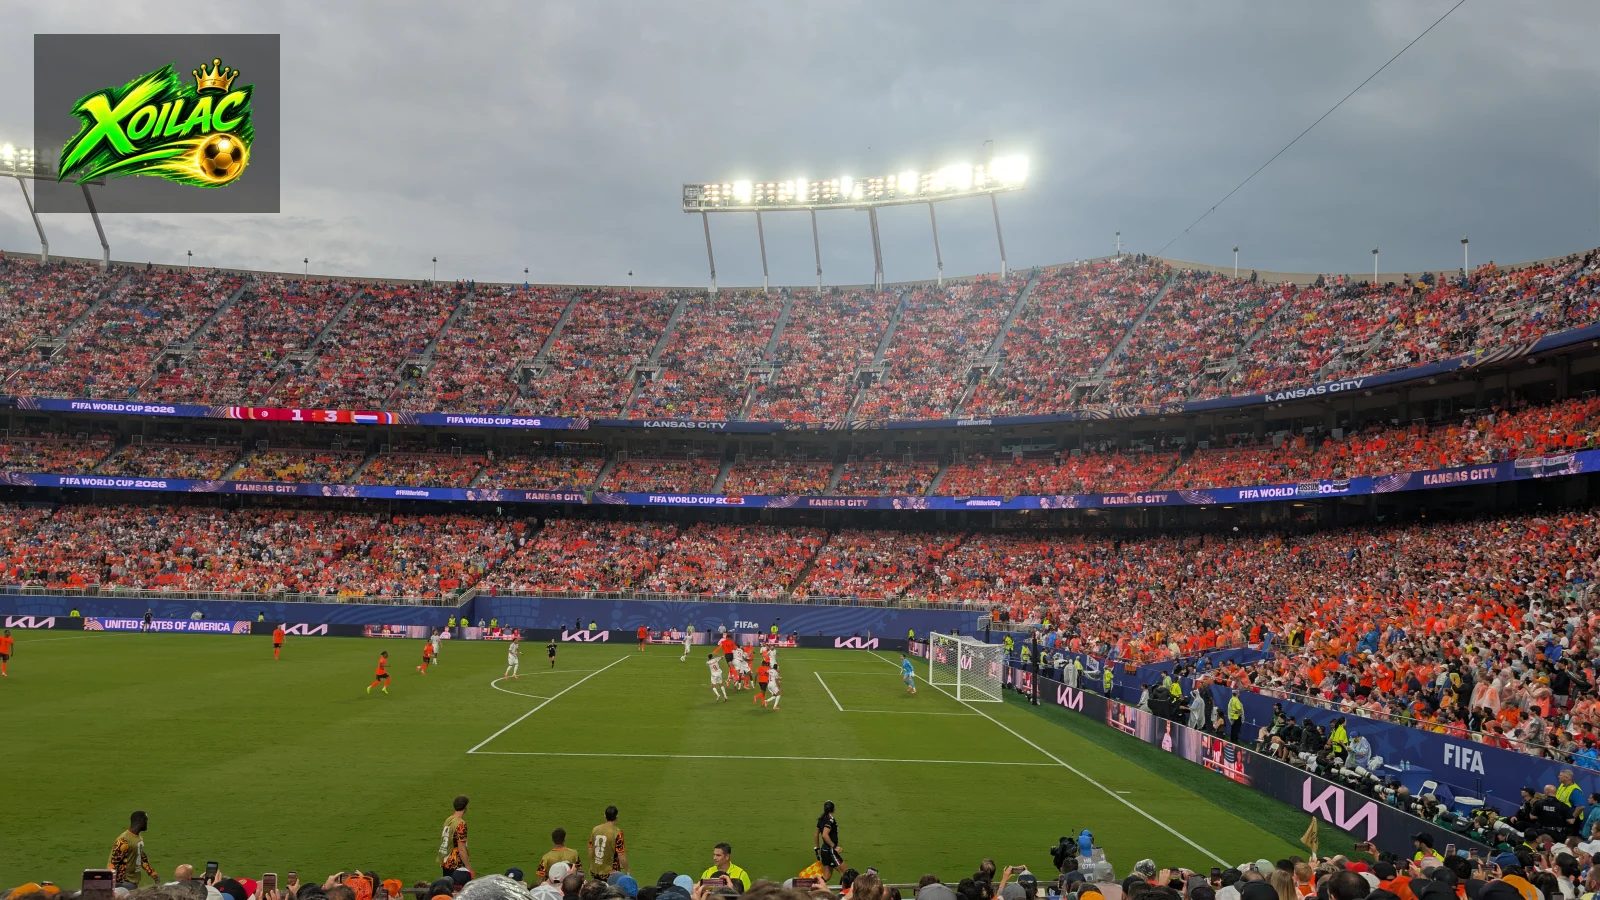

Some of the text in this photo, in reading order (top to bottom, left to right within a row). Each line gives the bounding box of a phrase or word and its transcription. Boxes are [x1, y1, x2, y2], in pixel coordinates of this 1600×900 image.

[1265, 379, 1364, 403] KANSAS CITY
[71, 402, 175, 414] FIFA WORLD CUP 2026
[291, 409, 338, 422] 1 3
[446, 416, 541, 426] FIFA WORLD CUP 2026
[643, 420, 727, 429] KANSAS CITY
[1423, 468, 1497, 484] KANSAS CITY
[59, 477, 167, 489] FIFA WORLD CUP 2026
[235, 483, 297, 493] KANSAS CITY
[525, 492, 563, 501] KANSAS
[649, 495, 667, 504] FIFA
[668, 496, 698, 504] WORLD
[698, 496, 715, 504] CUP
[1239, 490, 1259, 500] FIFA
[1259, 488, 1294, 499] WORLD
[809, 498, 868, 507] KANSAS CITY
[1102, 495, 1168, 505] KANSAS CITY
[104, 619, 231, 632] UNITED SATES OF AMERICA
[734, 620, 753, 629] FIFA
[1444, 742, 1485, 775] FIFA
